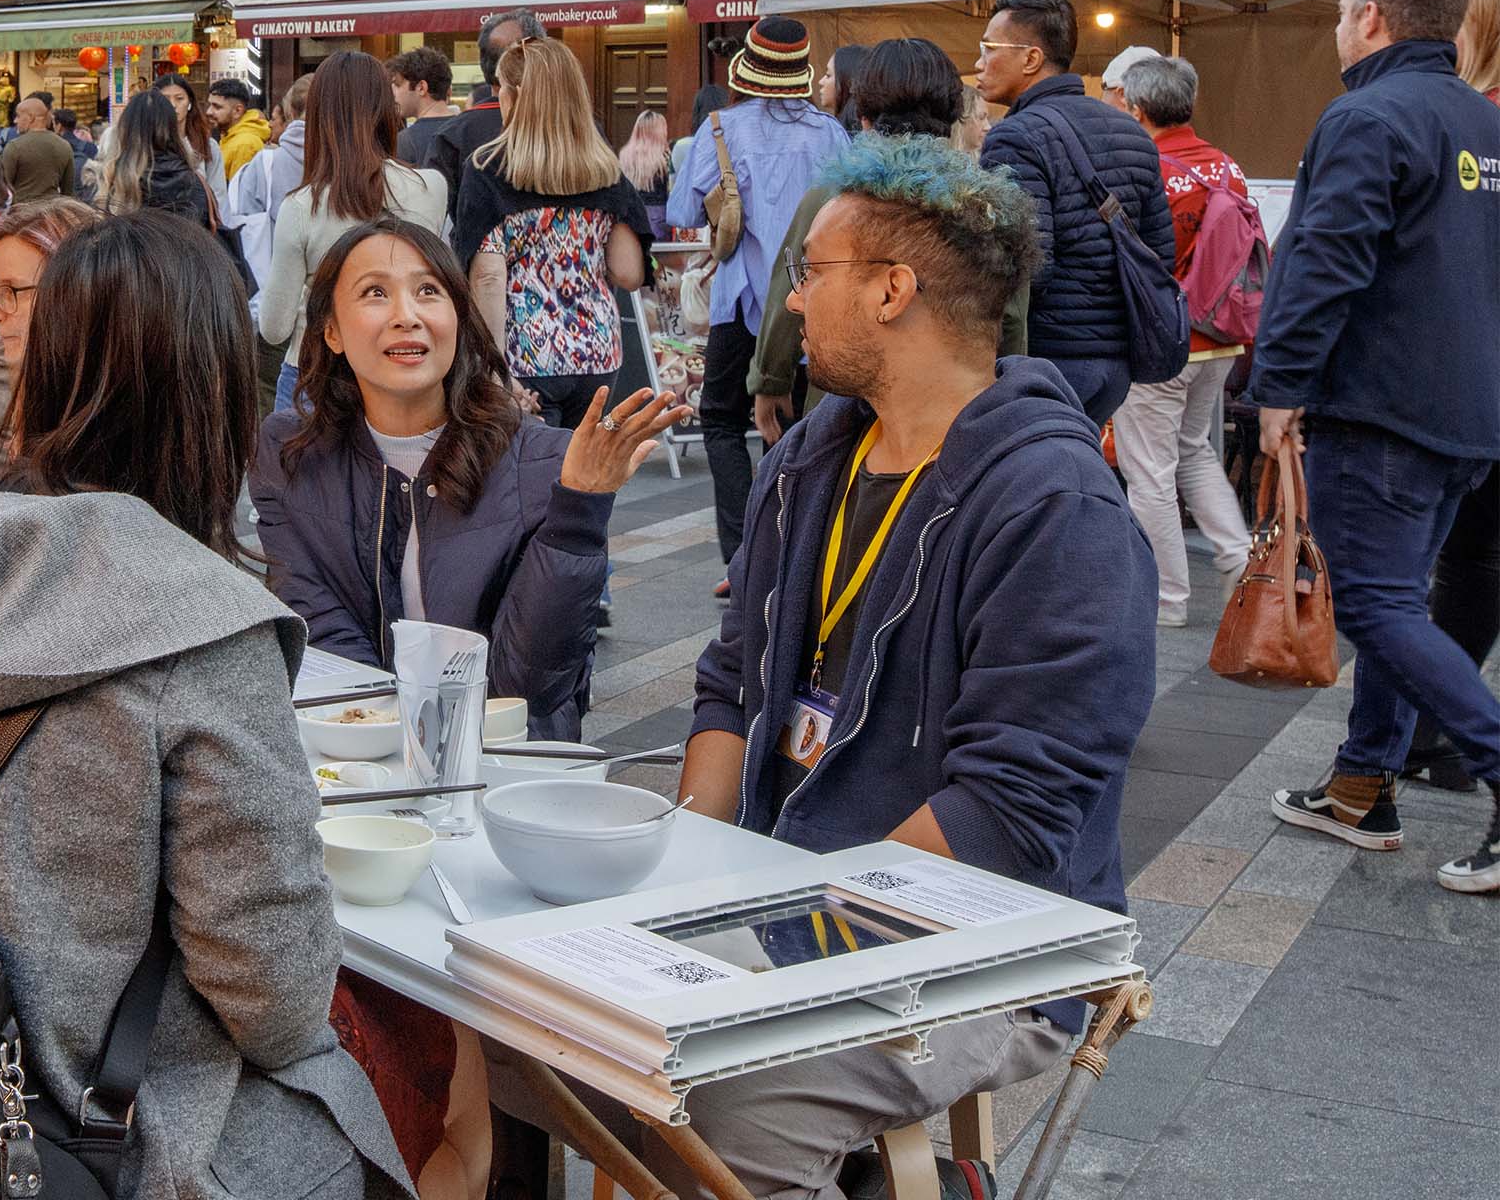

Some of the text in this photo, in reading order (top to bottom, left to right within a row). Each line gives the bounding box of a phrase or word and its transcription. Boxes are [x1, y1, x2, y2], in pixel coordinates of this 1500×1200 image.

[252, 19, 356, 36] CHINATOWN BAKERY
[72, 28, 175, 44] CHINESE ART AND FASHIONS
